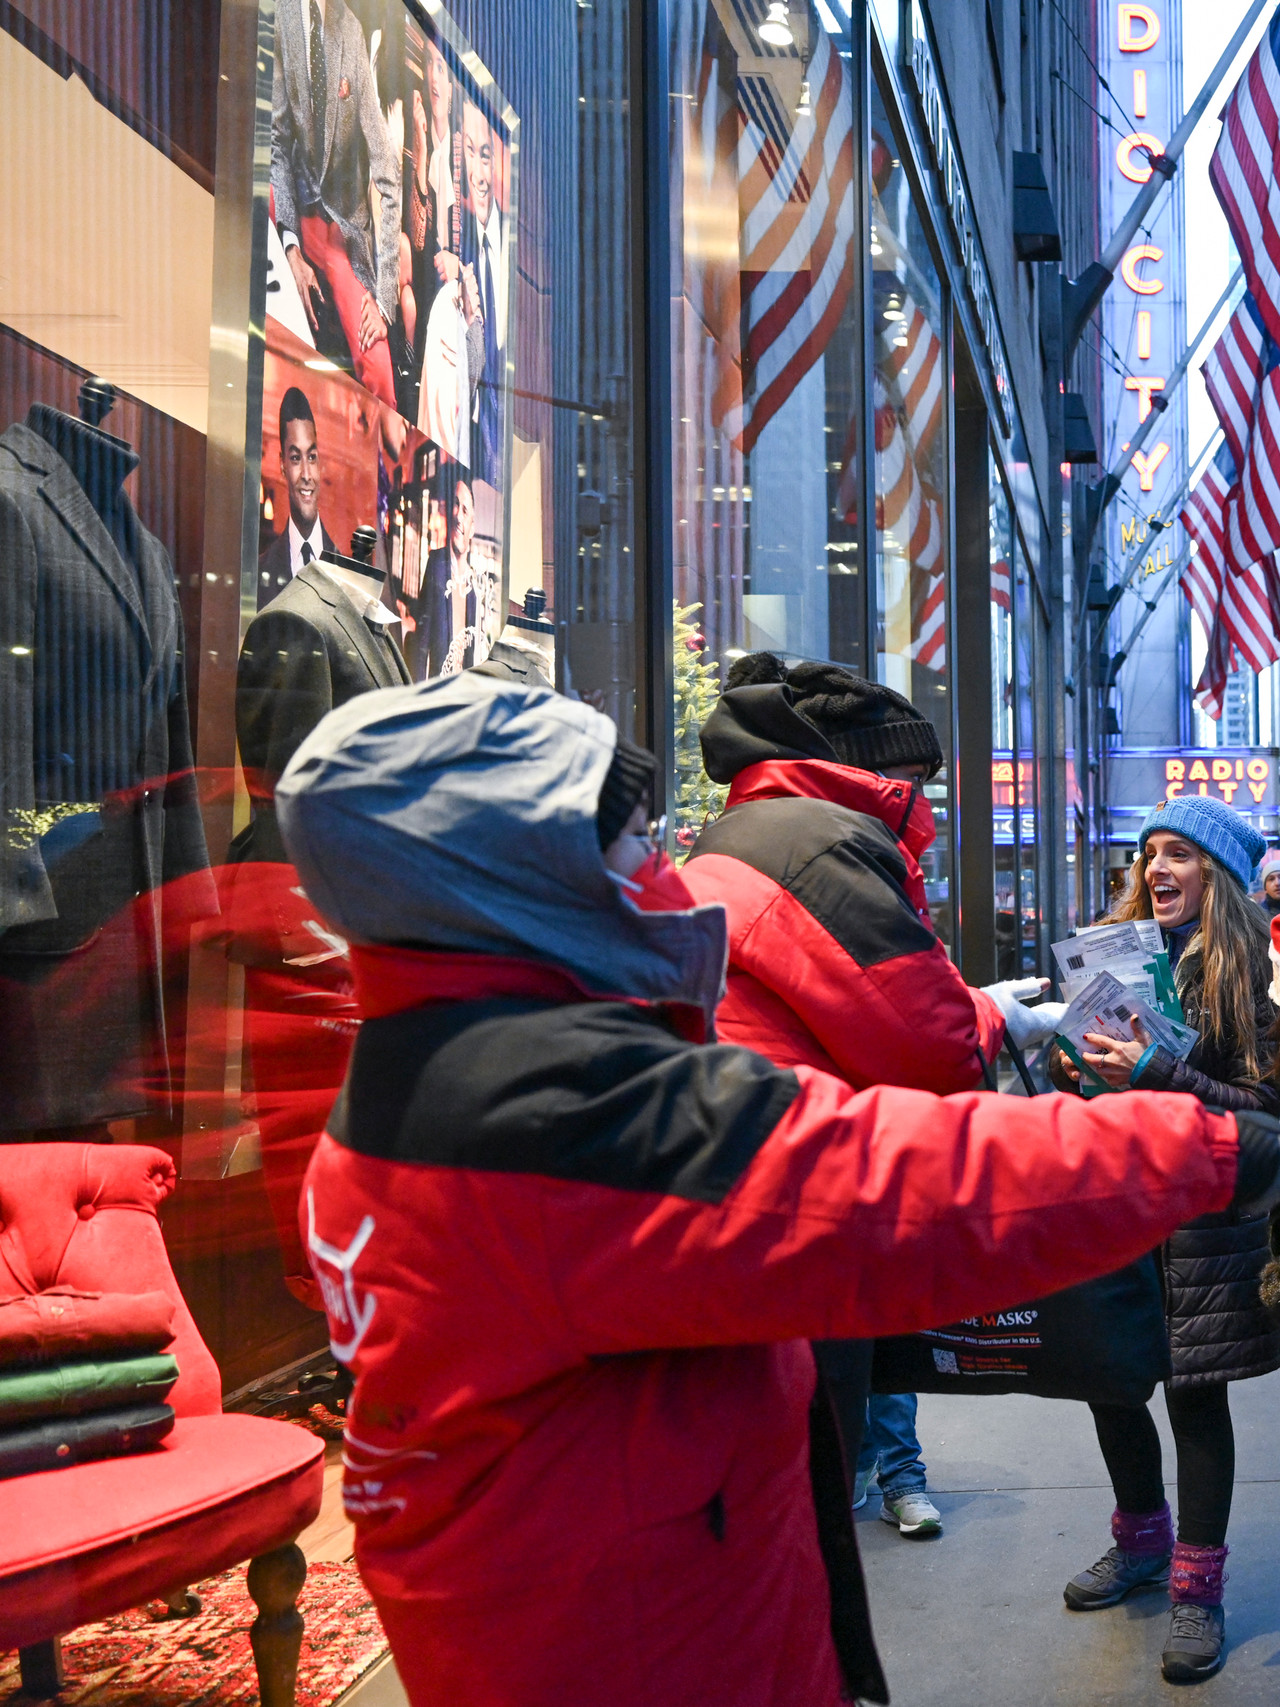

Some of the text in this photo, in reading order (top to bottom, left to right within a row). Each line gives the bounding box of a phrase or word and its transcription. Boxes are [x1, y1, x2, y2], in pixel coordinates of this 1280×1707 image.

[1121, 244, 1170, 491] CITY
[1165, 758, 1270, 781] RADIO
[1165, 781, 1268, 804] CITY
